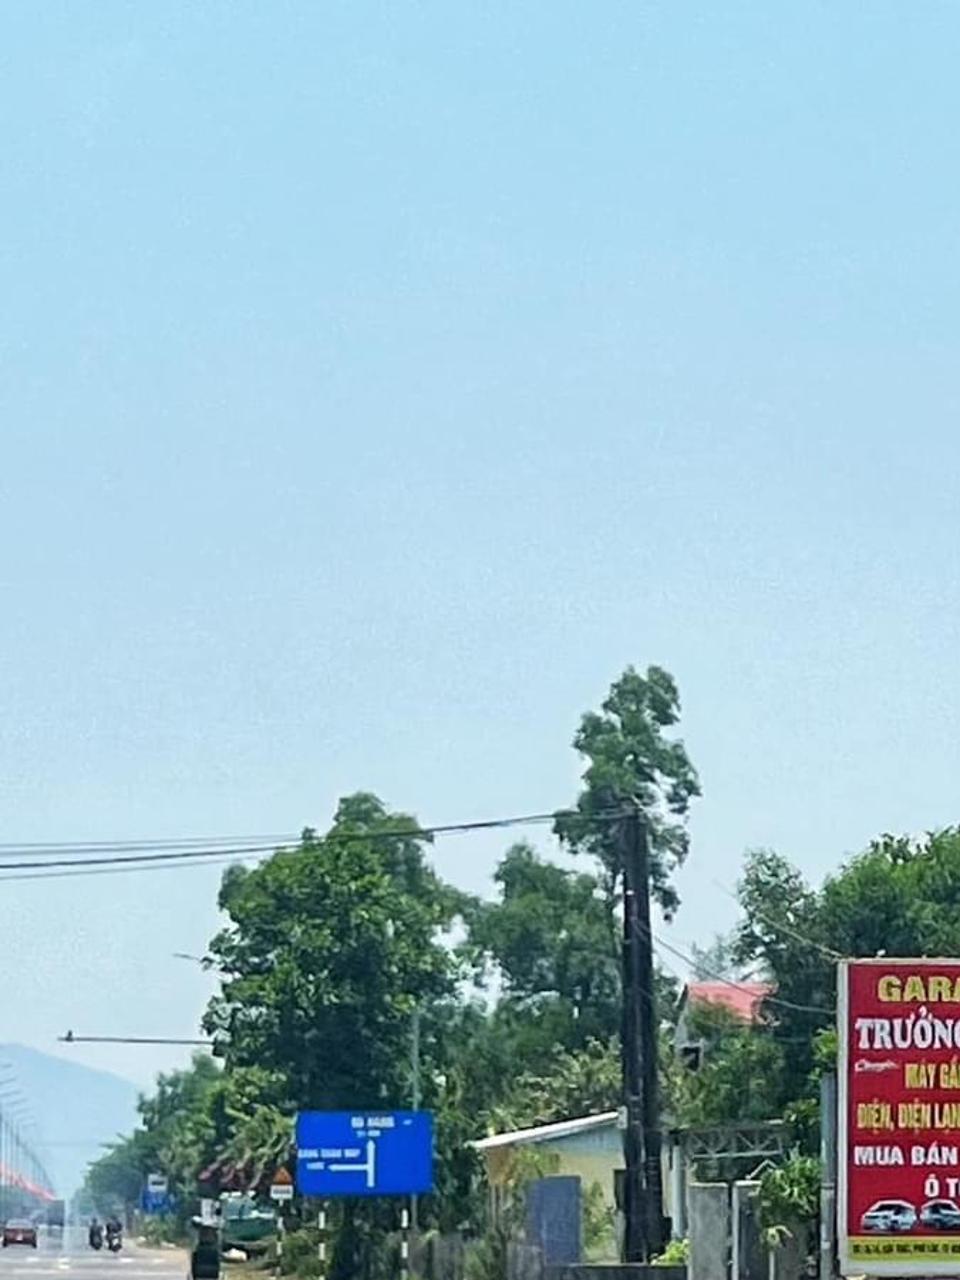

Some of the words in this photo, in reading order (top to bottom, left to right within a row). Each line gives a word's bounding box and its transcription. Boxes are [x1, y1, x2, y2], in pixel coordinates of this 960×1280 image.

[853, 1146, 904, 1166] MUA
[911, 1141, 958, 1166] BÁN
[924, 1173, 940, 1198] Ô
